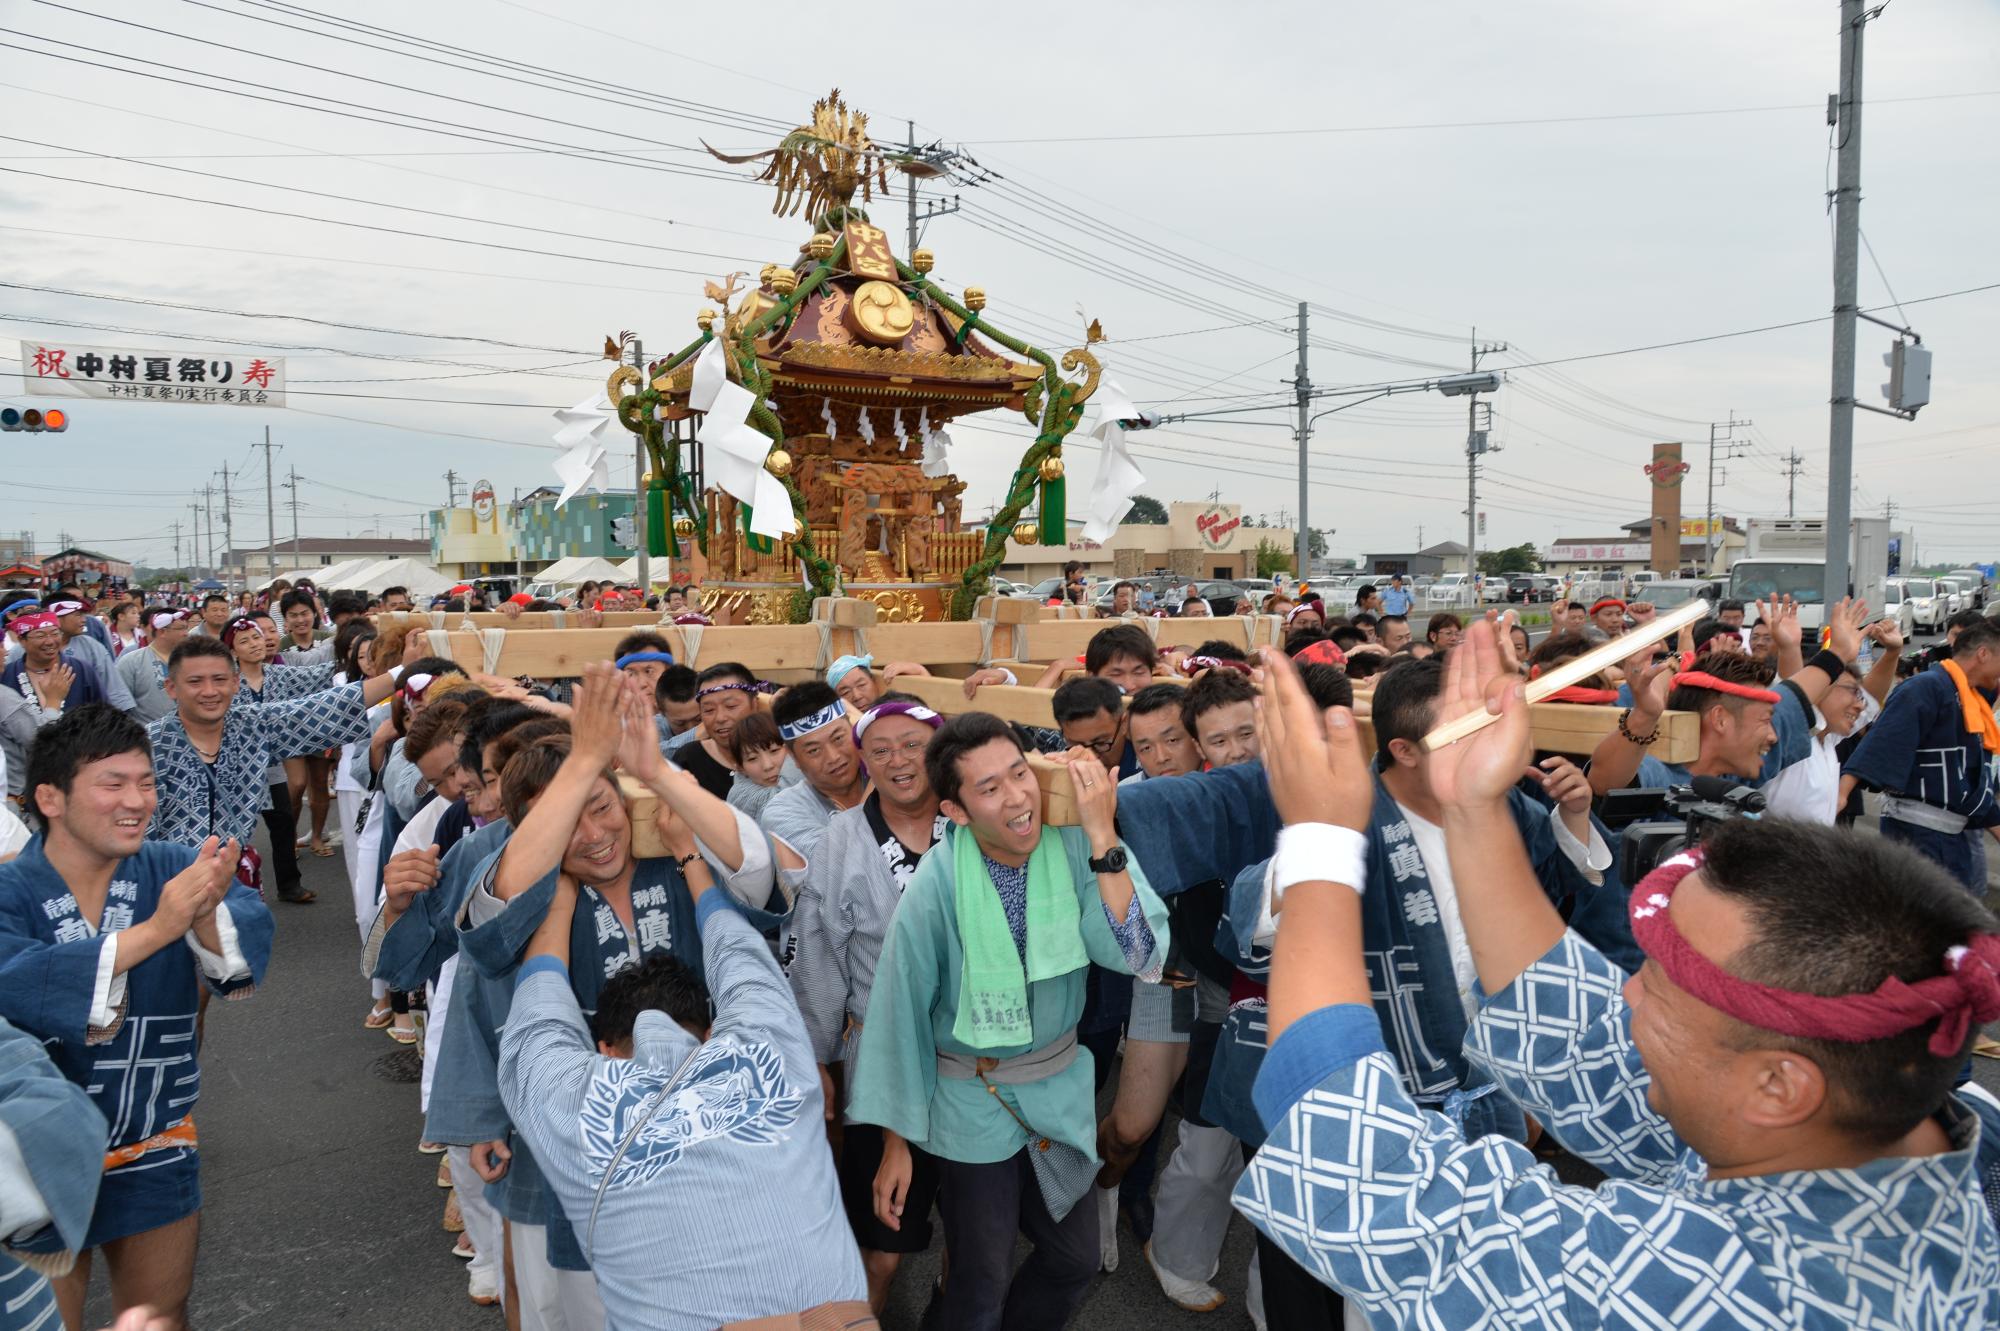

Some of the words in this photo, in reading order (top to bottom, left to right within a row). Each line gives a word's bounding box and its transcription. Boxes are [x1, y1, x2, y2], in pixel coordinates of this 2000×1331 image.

[31, 346, 71, 378] 祝
[76, 352, 233, 384] 中村夏祭り
[242, 359, 276, 389] 寿
[107, 384, 269, 404] 中村夏祭り実行委員会
